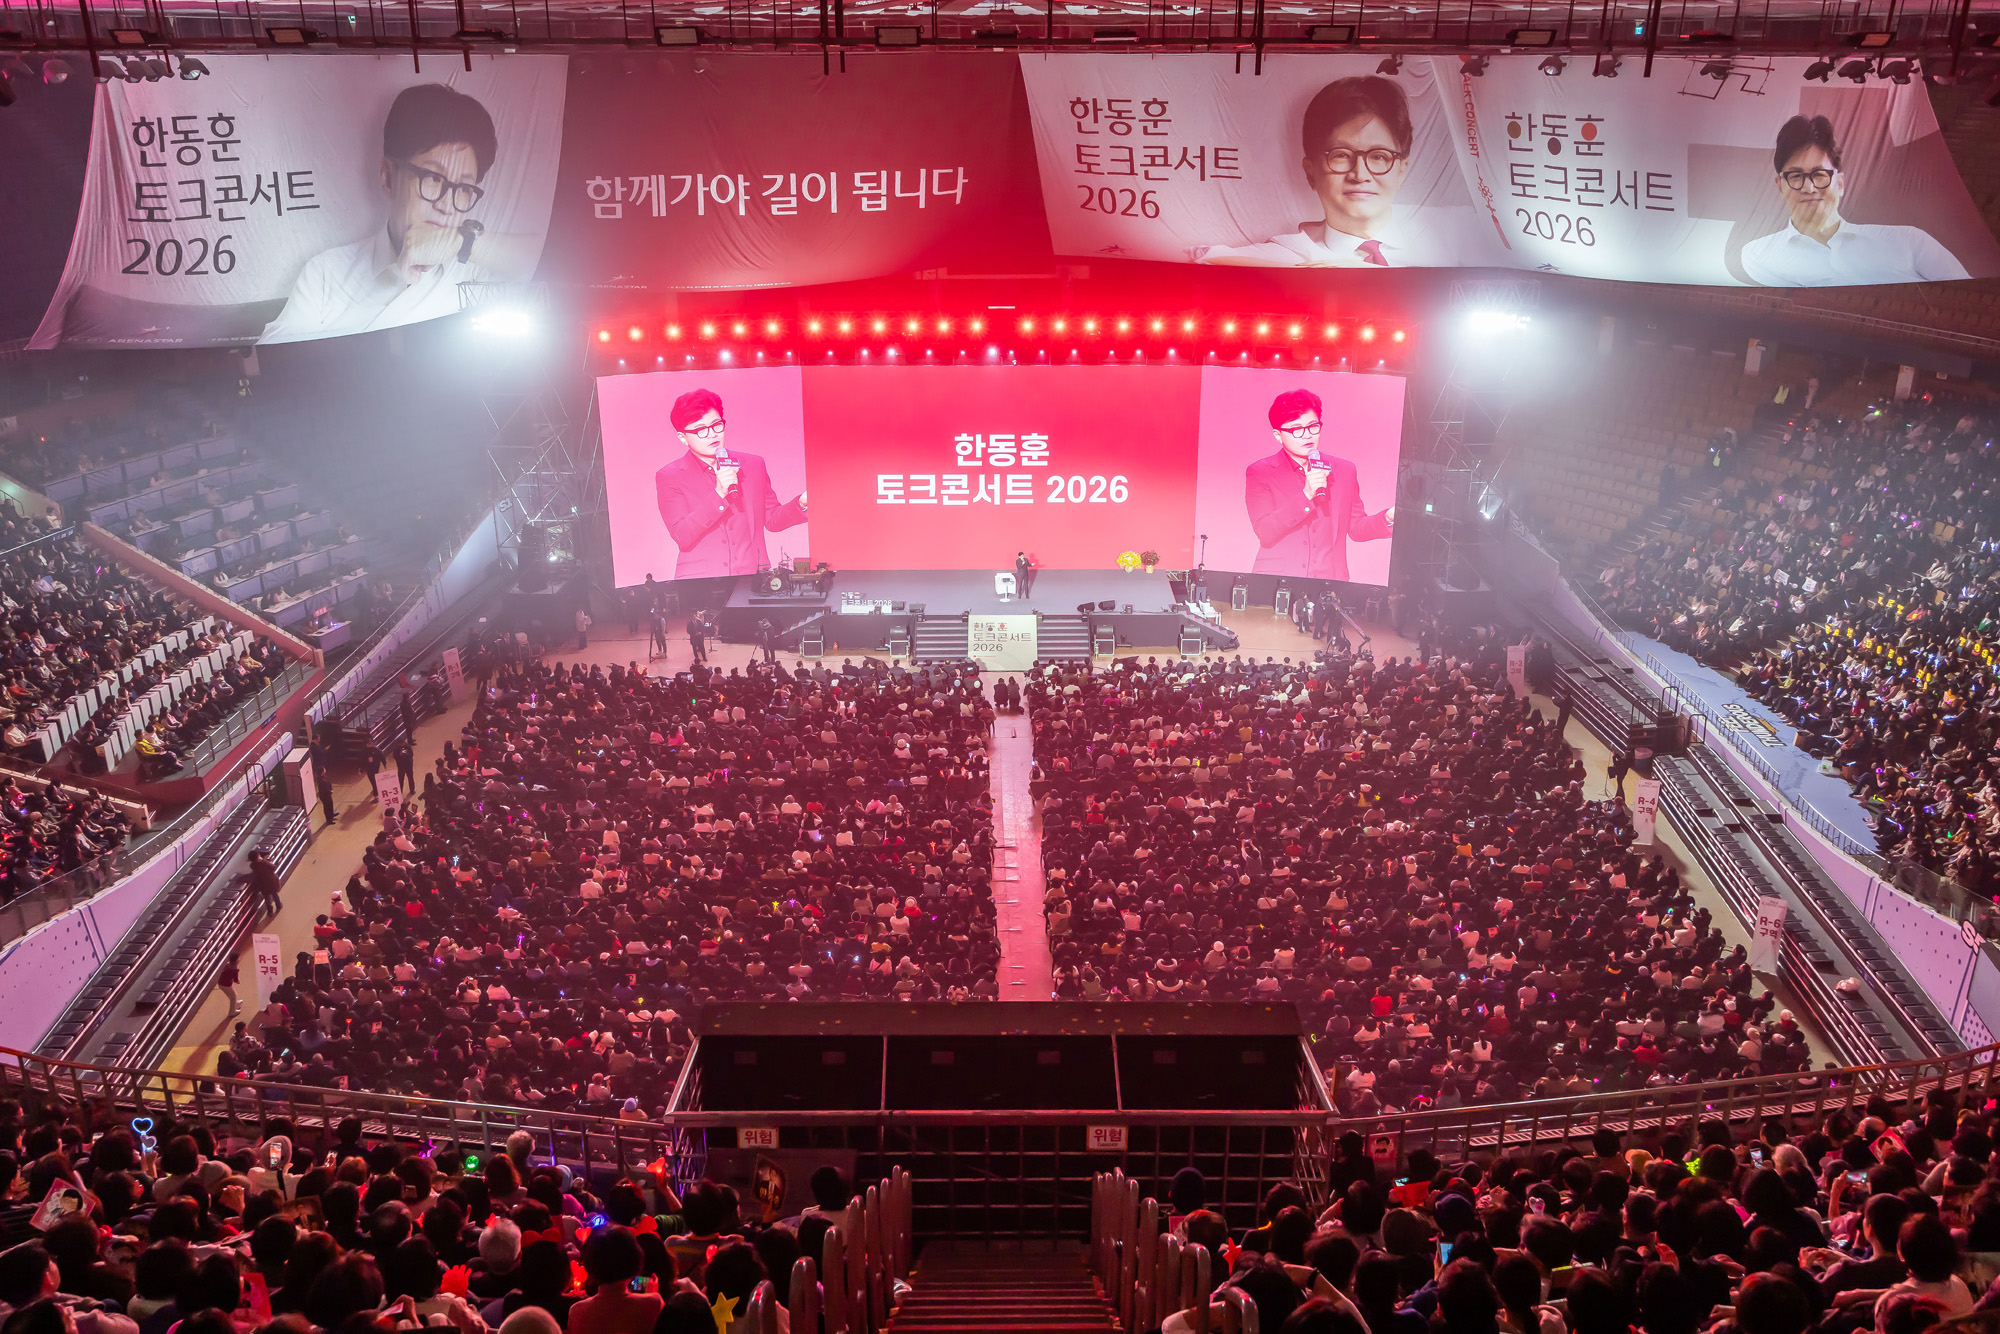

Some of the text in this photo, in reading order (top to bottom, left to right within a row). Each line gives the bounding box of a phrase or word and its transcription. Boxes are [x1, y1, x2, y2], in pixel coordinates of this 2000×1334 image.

[1069, 96, 1172, 136] 한동훈
[1462, 72, 1480, 159] ALK CONCERT
[132, 112, 241, 168] 한동훈
[1505, 111, 1605, 157] 한동훈
[1074, 143, 1243, 182] 토크콘서트
[585, 166, 969, 219] 함께가야 길이 됩니다
[1510, 163, 1675, 212] 토크콘서트
[127, 170, 320, 222] 토크콘서트
[1077, 184, 1160, 219] 2026
[1515, 207, 1596, 247] 2026
[121, 234, 236, 276] 2026
[954, 432, 1050, 467] 한동훈
[876, 473, 1129, 506] 토크콘서트 2026
[973, 622, 1008, 632] 한동훈
[973, 632, 1032, 643] 토크콘서트
[973, 643, 1003, 652] 2026
[1510, 660, 1523, 668] R-2
[382, 787, 399, 798] R-3
[385, 797, 399, 807] 구역
[1638, 796, 1656, 806] R-4
[1638, 806, 1653, 815] 구역
[1760, 916, 1781, 928] R-6
[1760, 927, 1778, 939] 구역
[259, 954, 279, 964] R-5
[260, 966, 278, 976] 구역
[744, 1130, 772, 1145] 위험
[1093, 1128, 1122, 1142] 위험
